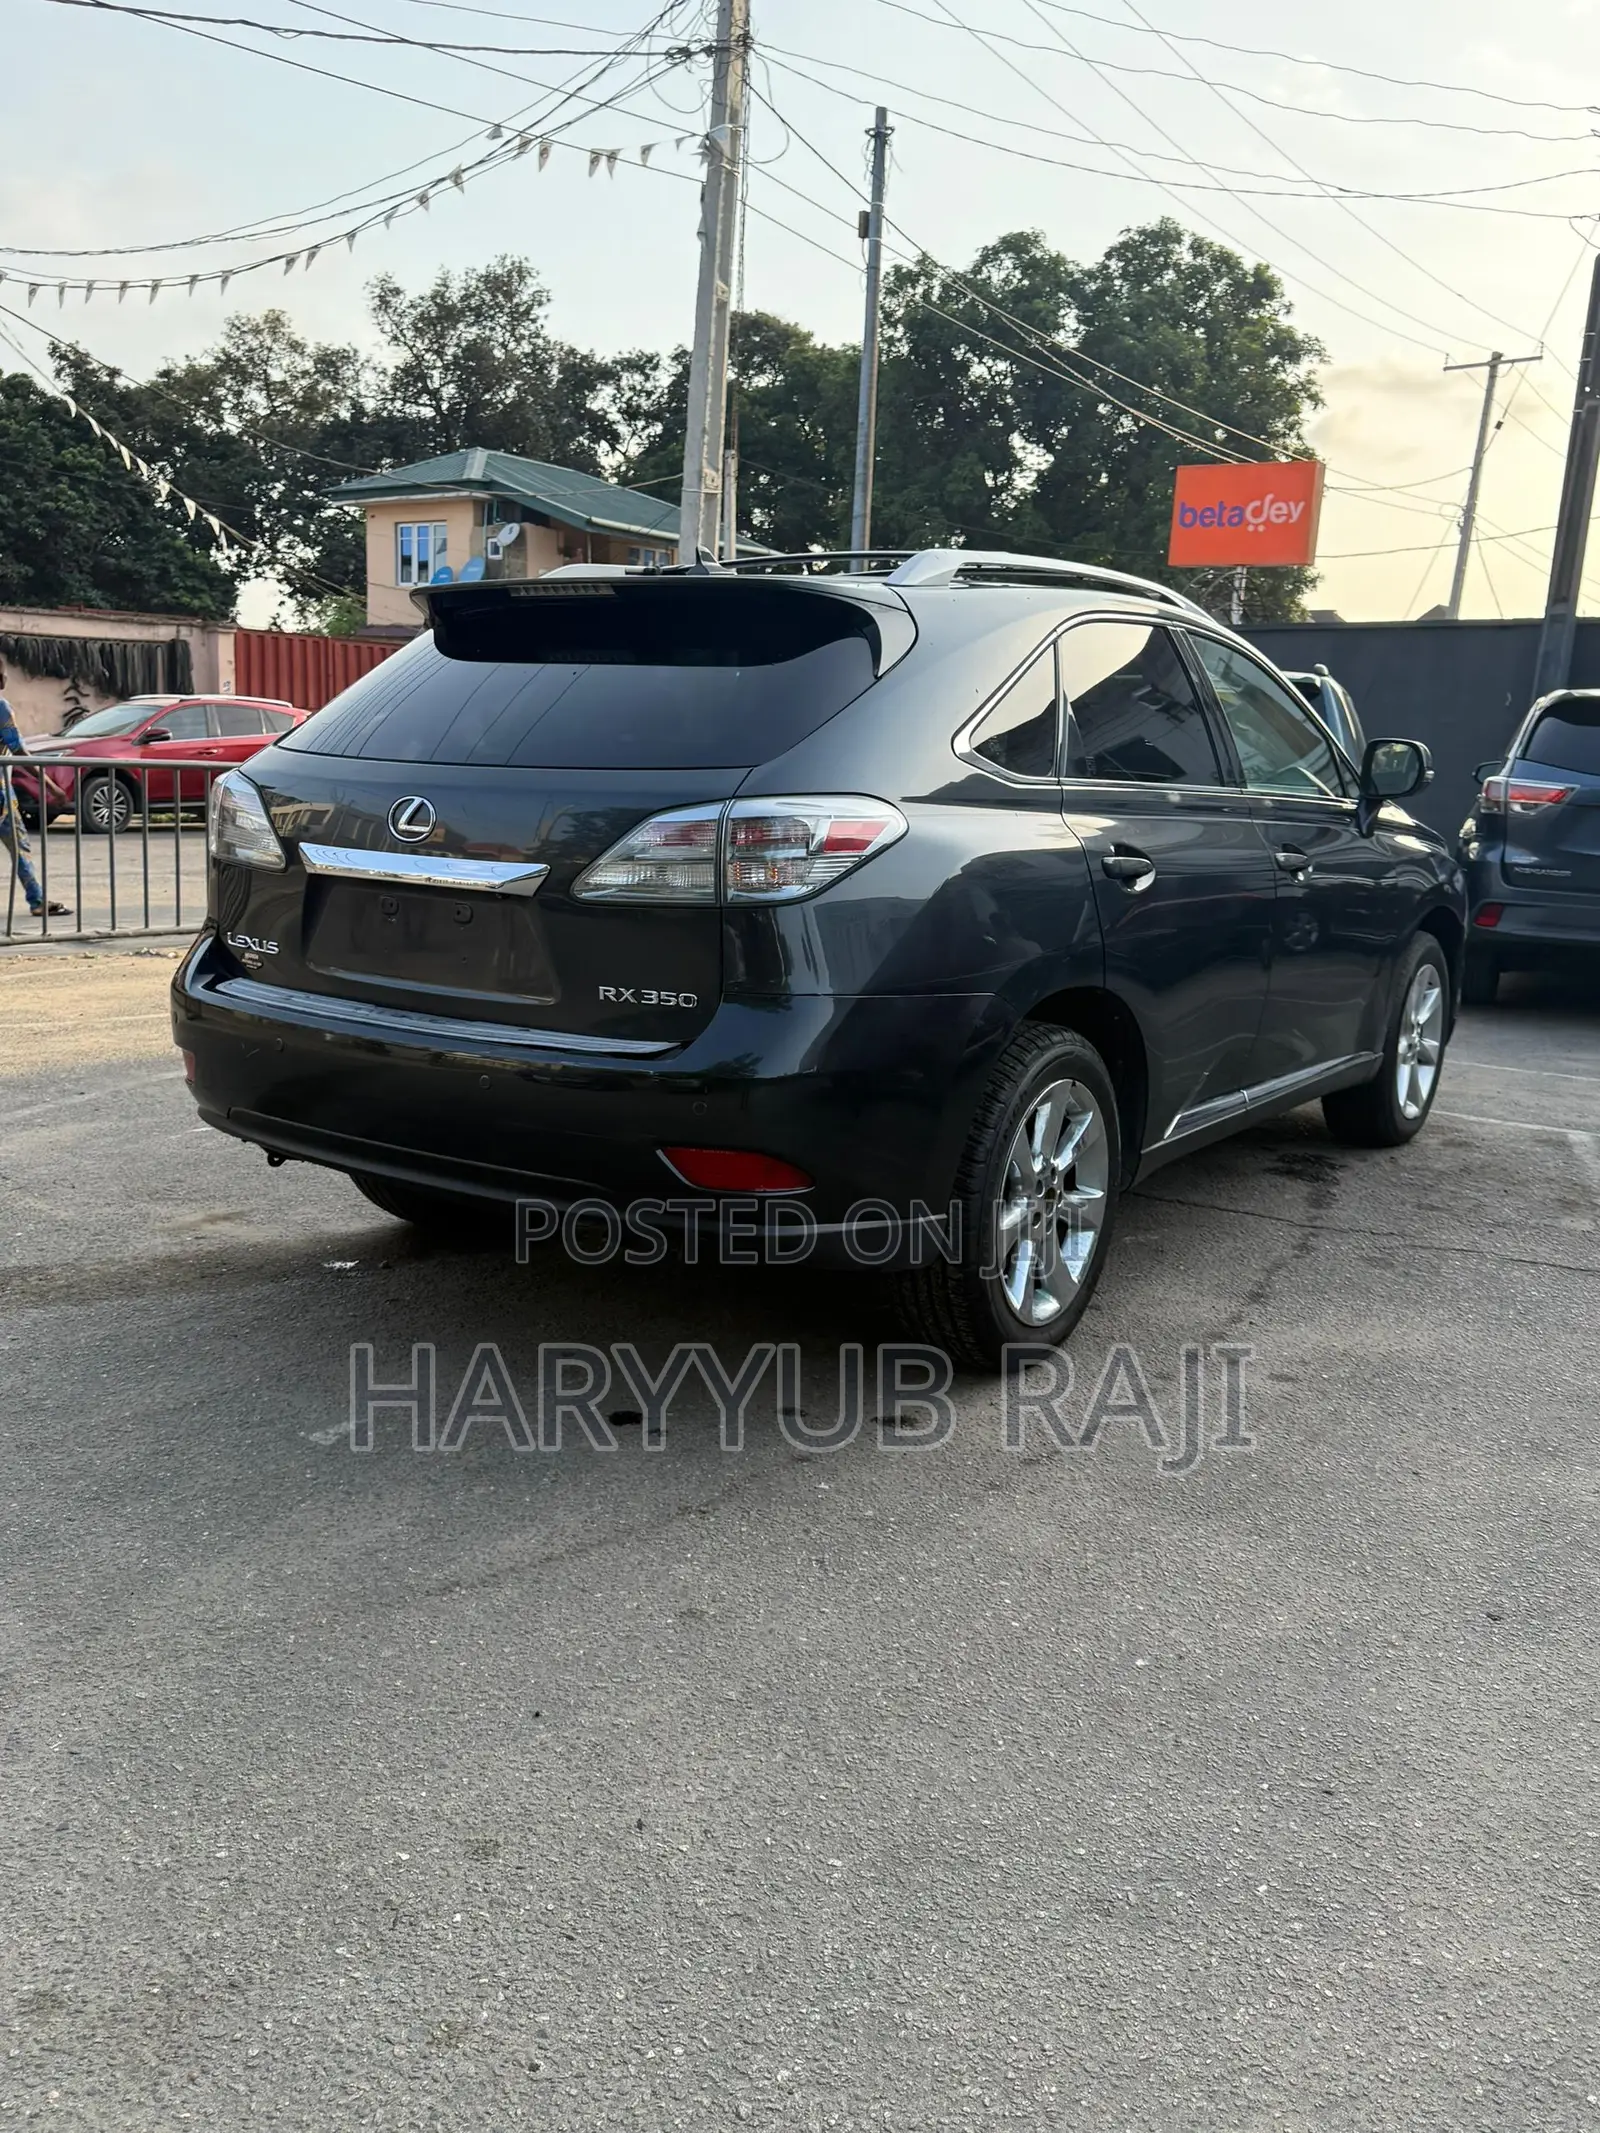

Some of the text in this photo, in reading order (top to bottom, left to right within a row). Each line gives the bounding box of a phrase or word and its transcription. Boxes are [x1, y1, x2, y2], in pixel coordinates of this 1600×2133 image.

[227, 931, 280, 954] LEXUS
[598, 985, 698, 1008] RX 350
